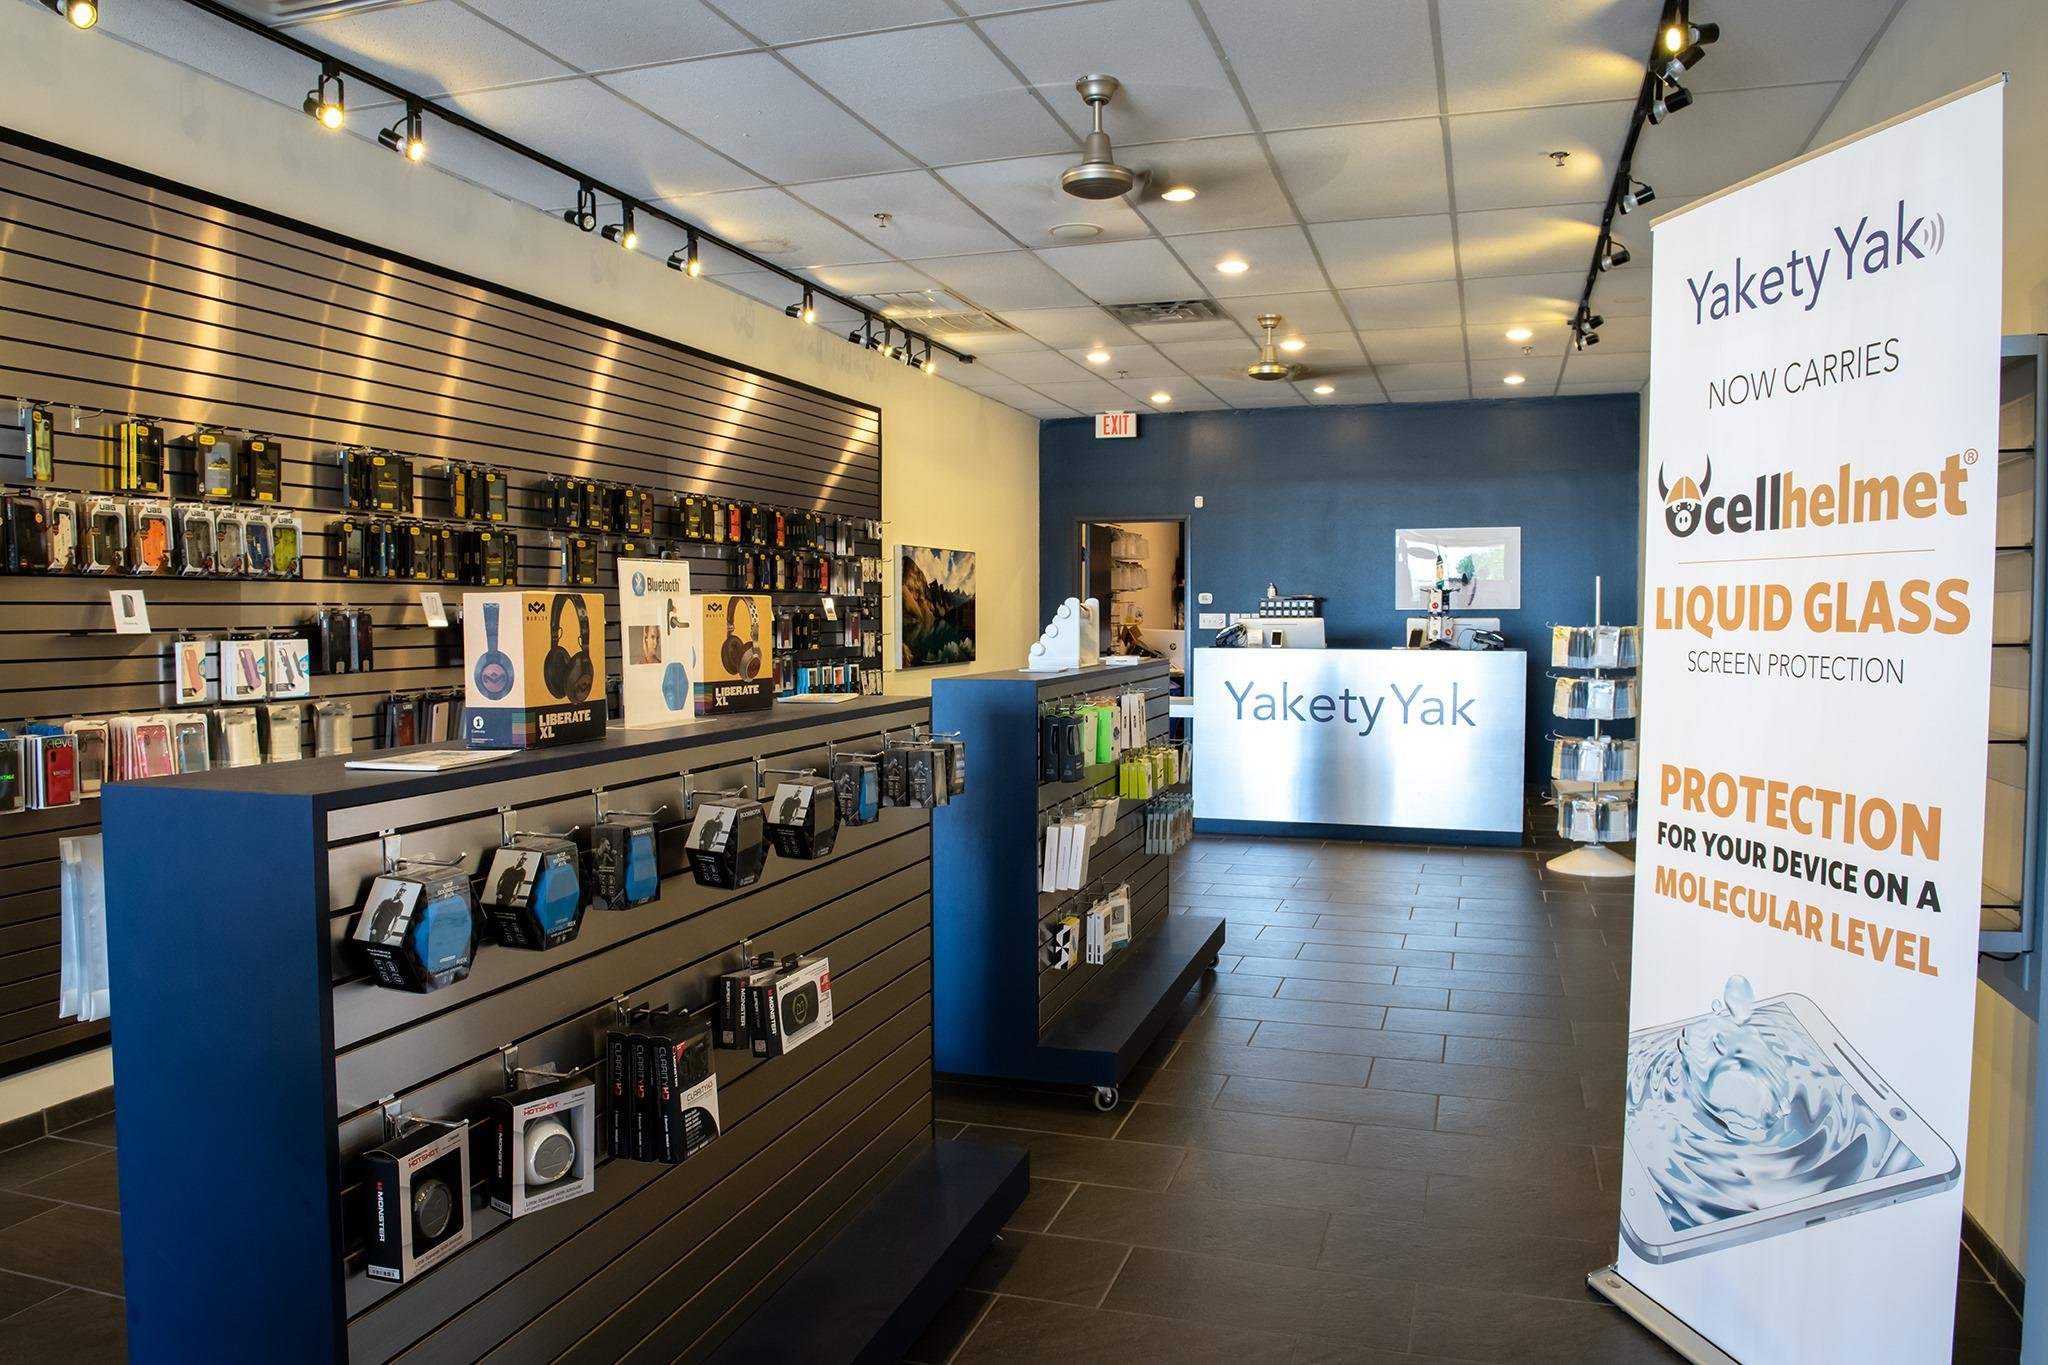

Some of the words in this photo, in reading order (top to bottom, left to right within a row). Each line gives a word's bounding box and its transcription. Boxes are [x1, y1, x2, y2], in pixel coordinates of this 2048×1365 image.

[1687, 248, 1831, 325] Yakety
[1834, 199, 1926, 281] Yak
[1709, 367, 1777, 410] NOW
[1784, 337, 1900, 397] CARRIES
[1103, 415, 1129, 435] EXIT
[646, 577, 680, 593] Bluetooth
[1655, 583, 1793, 639] LIQUID
[1803, 577, 1971, 635] GLASS
[1687, 650, 1762, 677] SCREEN
[1768, 653, 1904, 684] PROTECTION
[714, 684, 760, 697] LIBERATE
[715, 697, 729, 707] XL
[1224, 680, 1385, 736] Yakety
[1391, 682, 1477, 727] Yak
[538, 709, 592, 728] LIBERATE
[539, 726, 555, 740] XL
[1660, 763, 1942, 862] PROTECTION
[1657, 820, 1698, 853] FOR
[1702, 830, 1767, 870] YOUR
[1773, 845, 1858, 894] DEVICE
[1863, 868, 1909, 906] ON
[1916, 880, 1942, 913] A
[1655, 864, 1824, 944] MOLECULAR
[1830, 912, 1940, 976] LEVEL
[768, 996, 777, 1036] MONSTER
[523, 1101, 560, 1117] HOTSHOT
[408, 1147, 440, 1169] HOTSHOT
[377, 1191, 386, 1243] MONSTER
